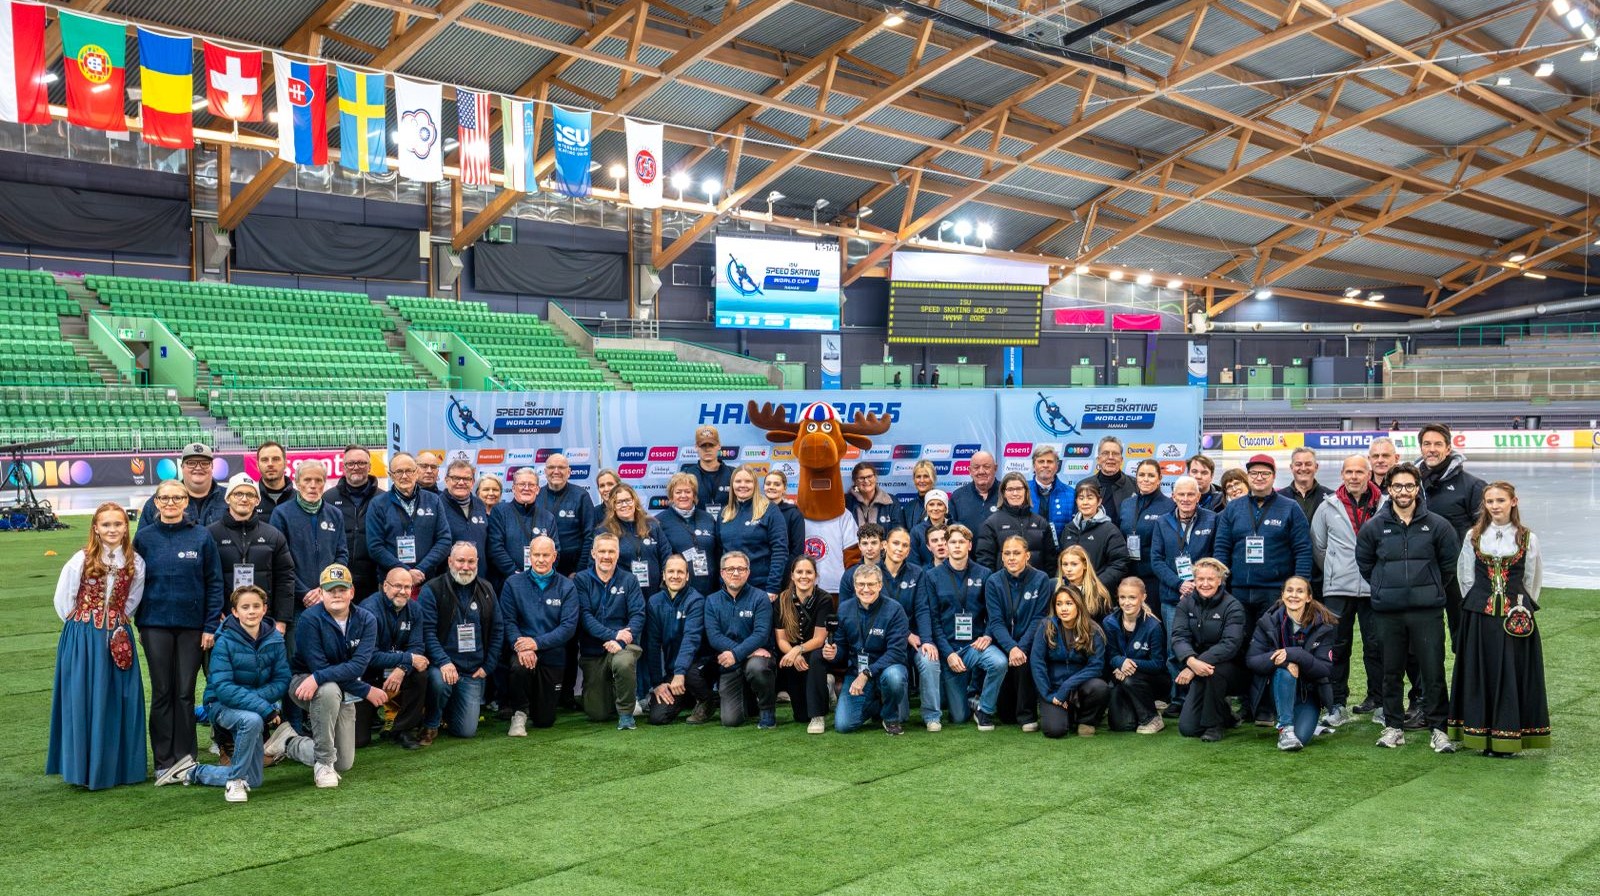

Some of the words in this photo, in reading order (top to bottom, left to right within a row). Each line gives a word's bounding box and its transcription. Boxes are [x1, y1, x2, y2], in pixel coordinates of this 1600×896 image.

[556, 123, 589, 147] ISU
[766, 267, 789, 275] SPEED
[790, 267, 820, 276] SKATING
[496, 408, 525, 416] SPEED
[526, 408, 564, 416] SKATING
[1084, 404, 1116, 412] SPEED
[1116, 403, 1158, 412] SKATING
[1239, 435, 1275, 449] Chocomel
